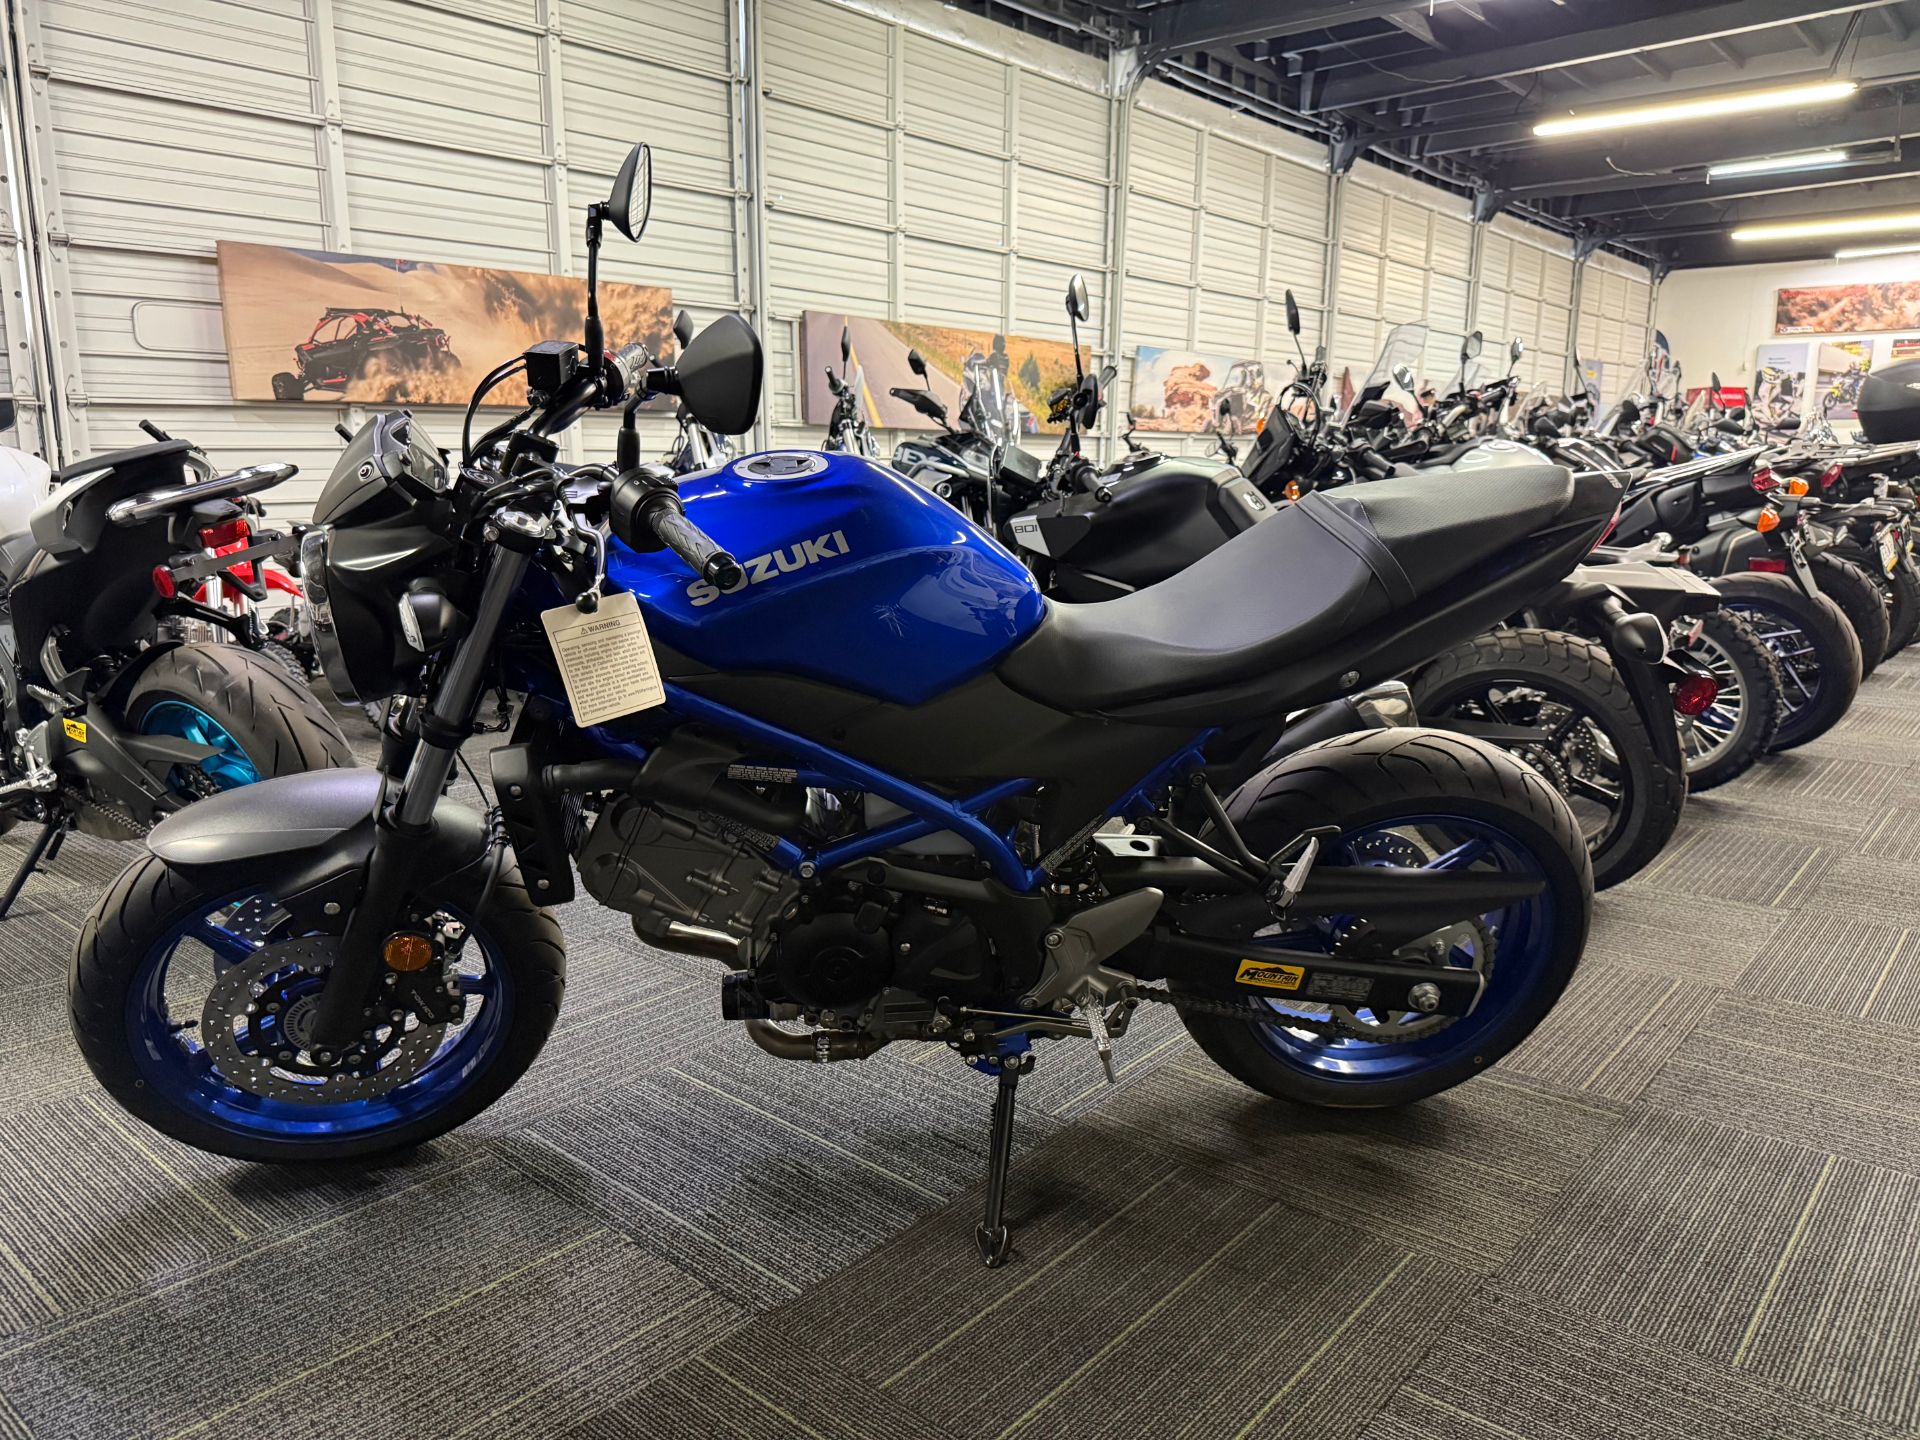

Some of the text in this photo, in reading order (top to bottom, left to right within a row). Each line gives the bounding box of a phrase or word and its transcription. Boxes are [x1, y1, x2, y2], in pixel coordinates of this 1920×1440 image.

[588, 620, 620, 633] WARNING
[1239, 968, 1300, 983] MOUNTAIN
[411, 988, 435, 1019] TOKICO
